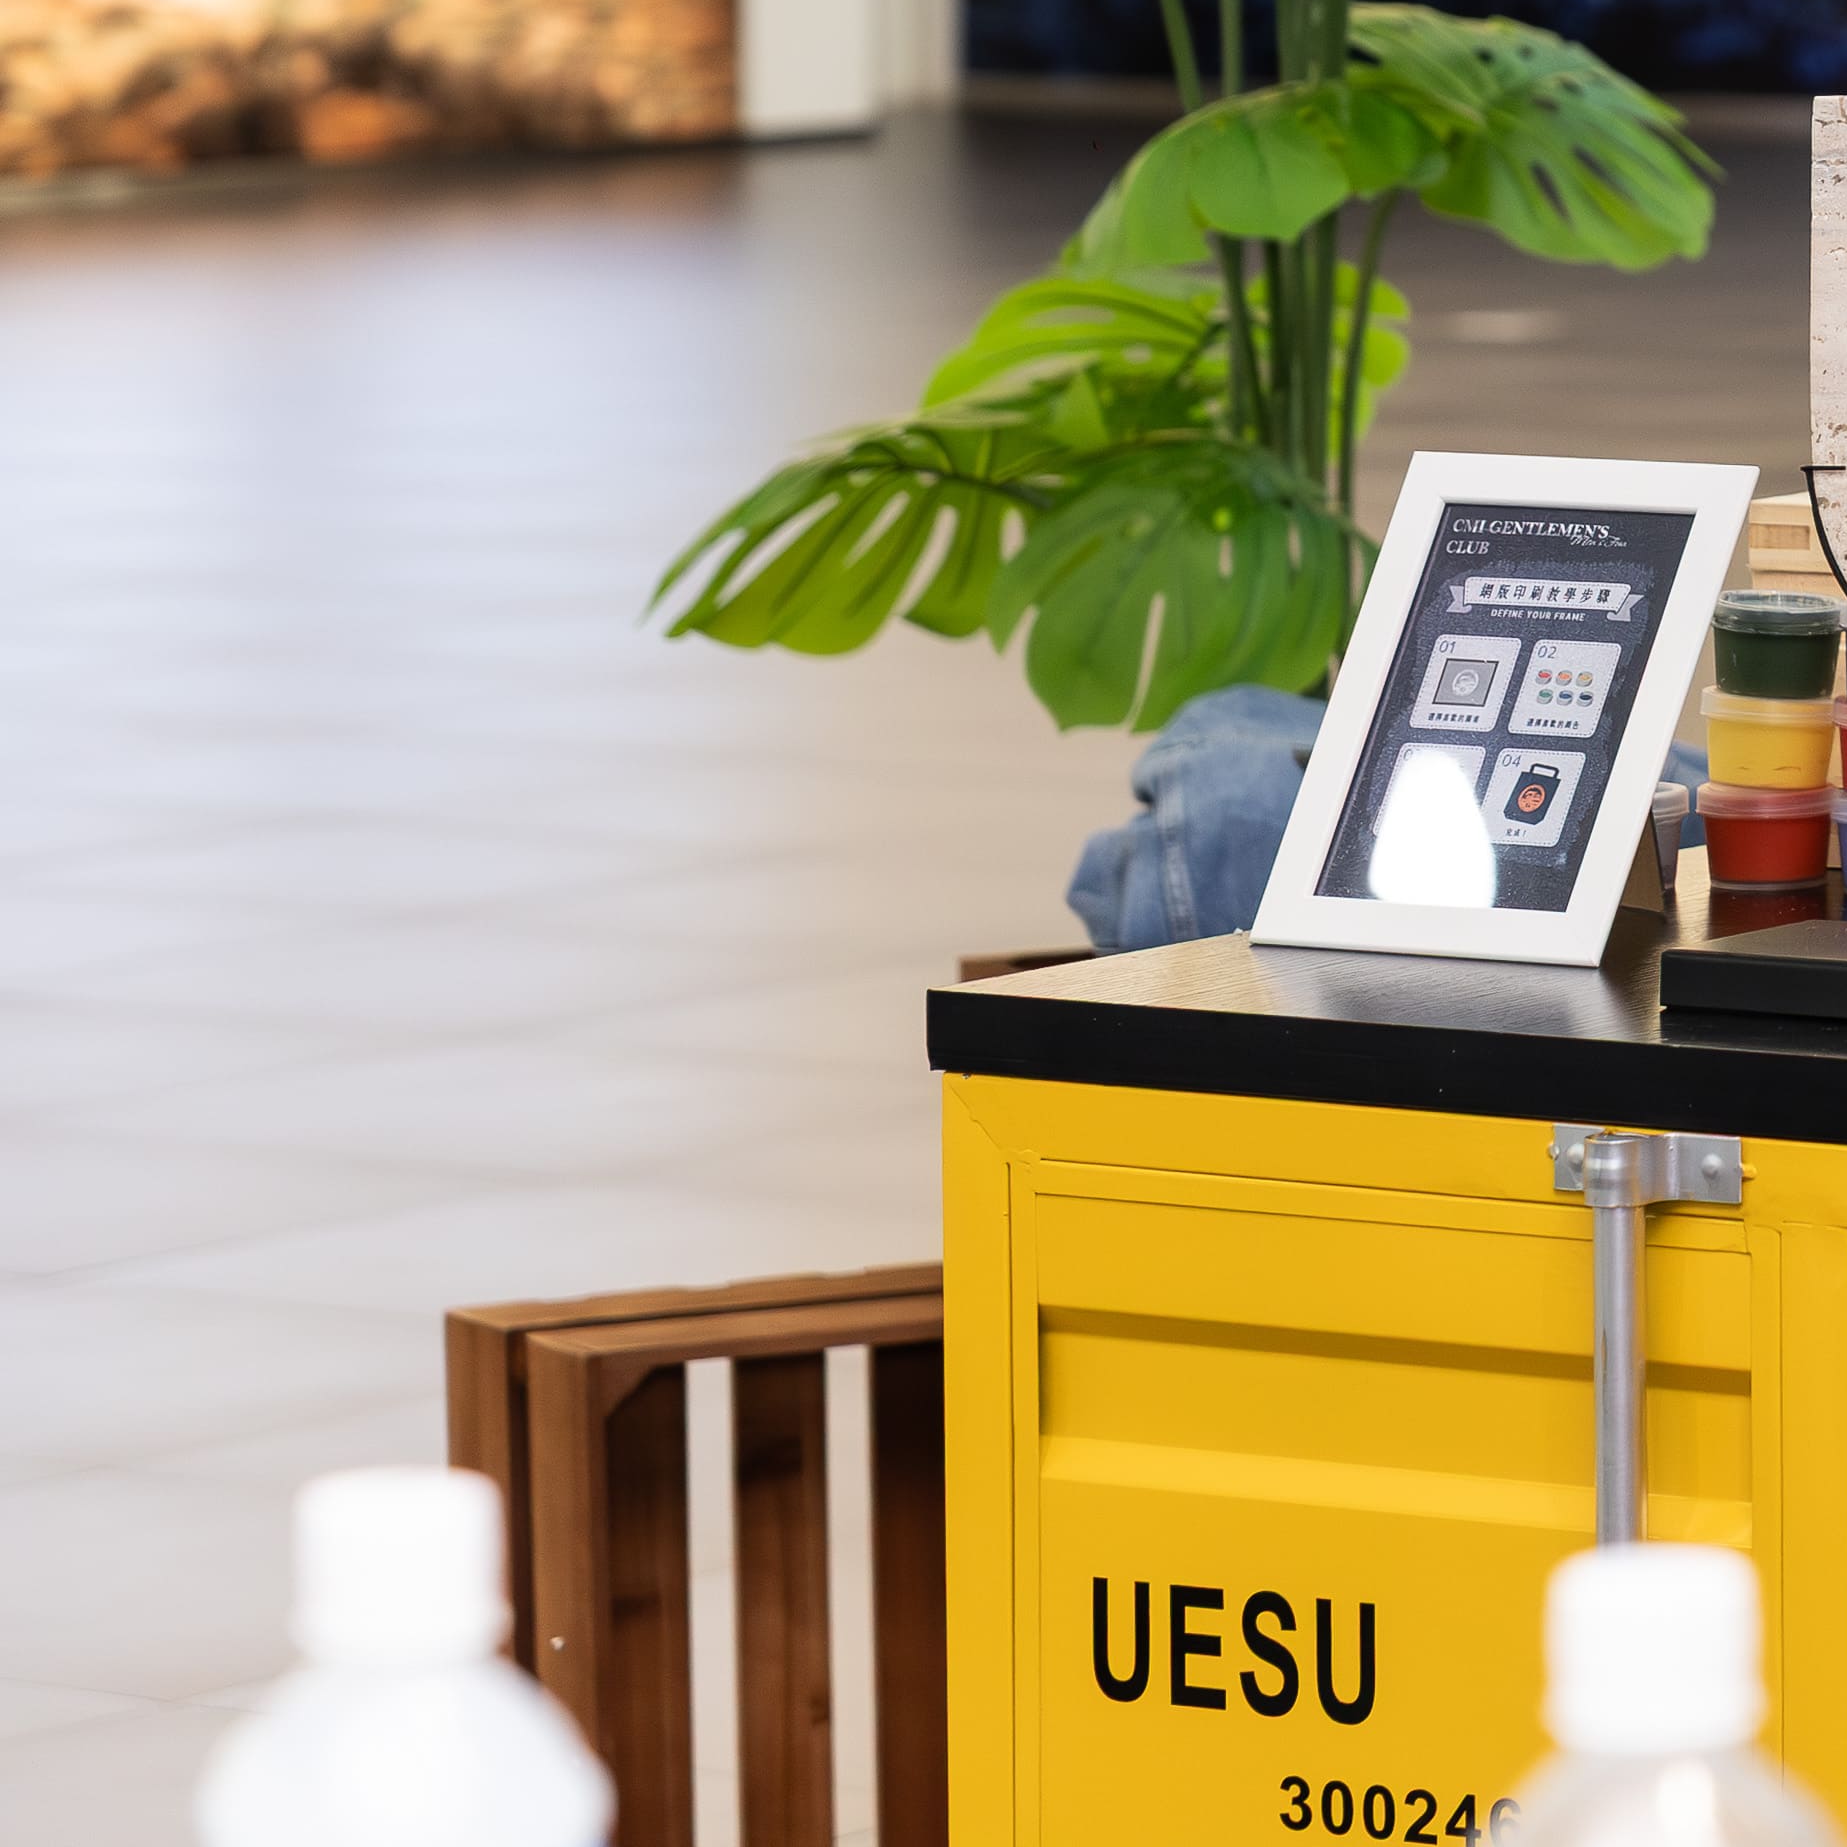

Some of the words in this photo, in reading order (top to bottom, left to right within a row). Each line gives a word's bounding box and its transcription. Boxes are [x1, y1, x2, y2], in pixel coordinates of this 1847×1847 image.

[1446, 540, 1490, 555] CLUB
[1491, 609, 1525, 619] DEFINE
[1527, 611, 1551, 620] YOUR
[1553, 612, 1586, 622] FRAME
[1439, 640, 1456, 653] 01
[1537, 645, 1557, 659] 02
[1502, 753, 1521, 768] 04
[1092, 1576, 1376, 1725] UESU
